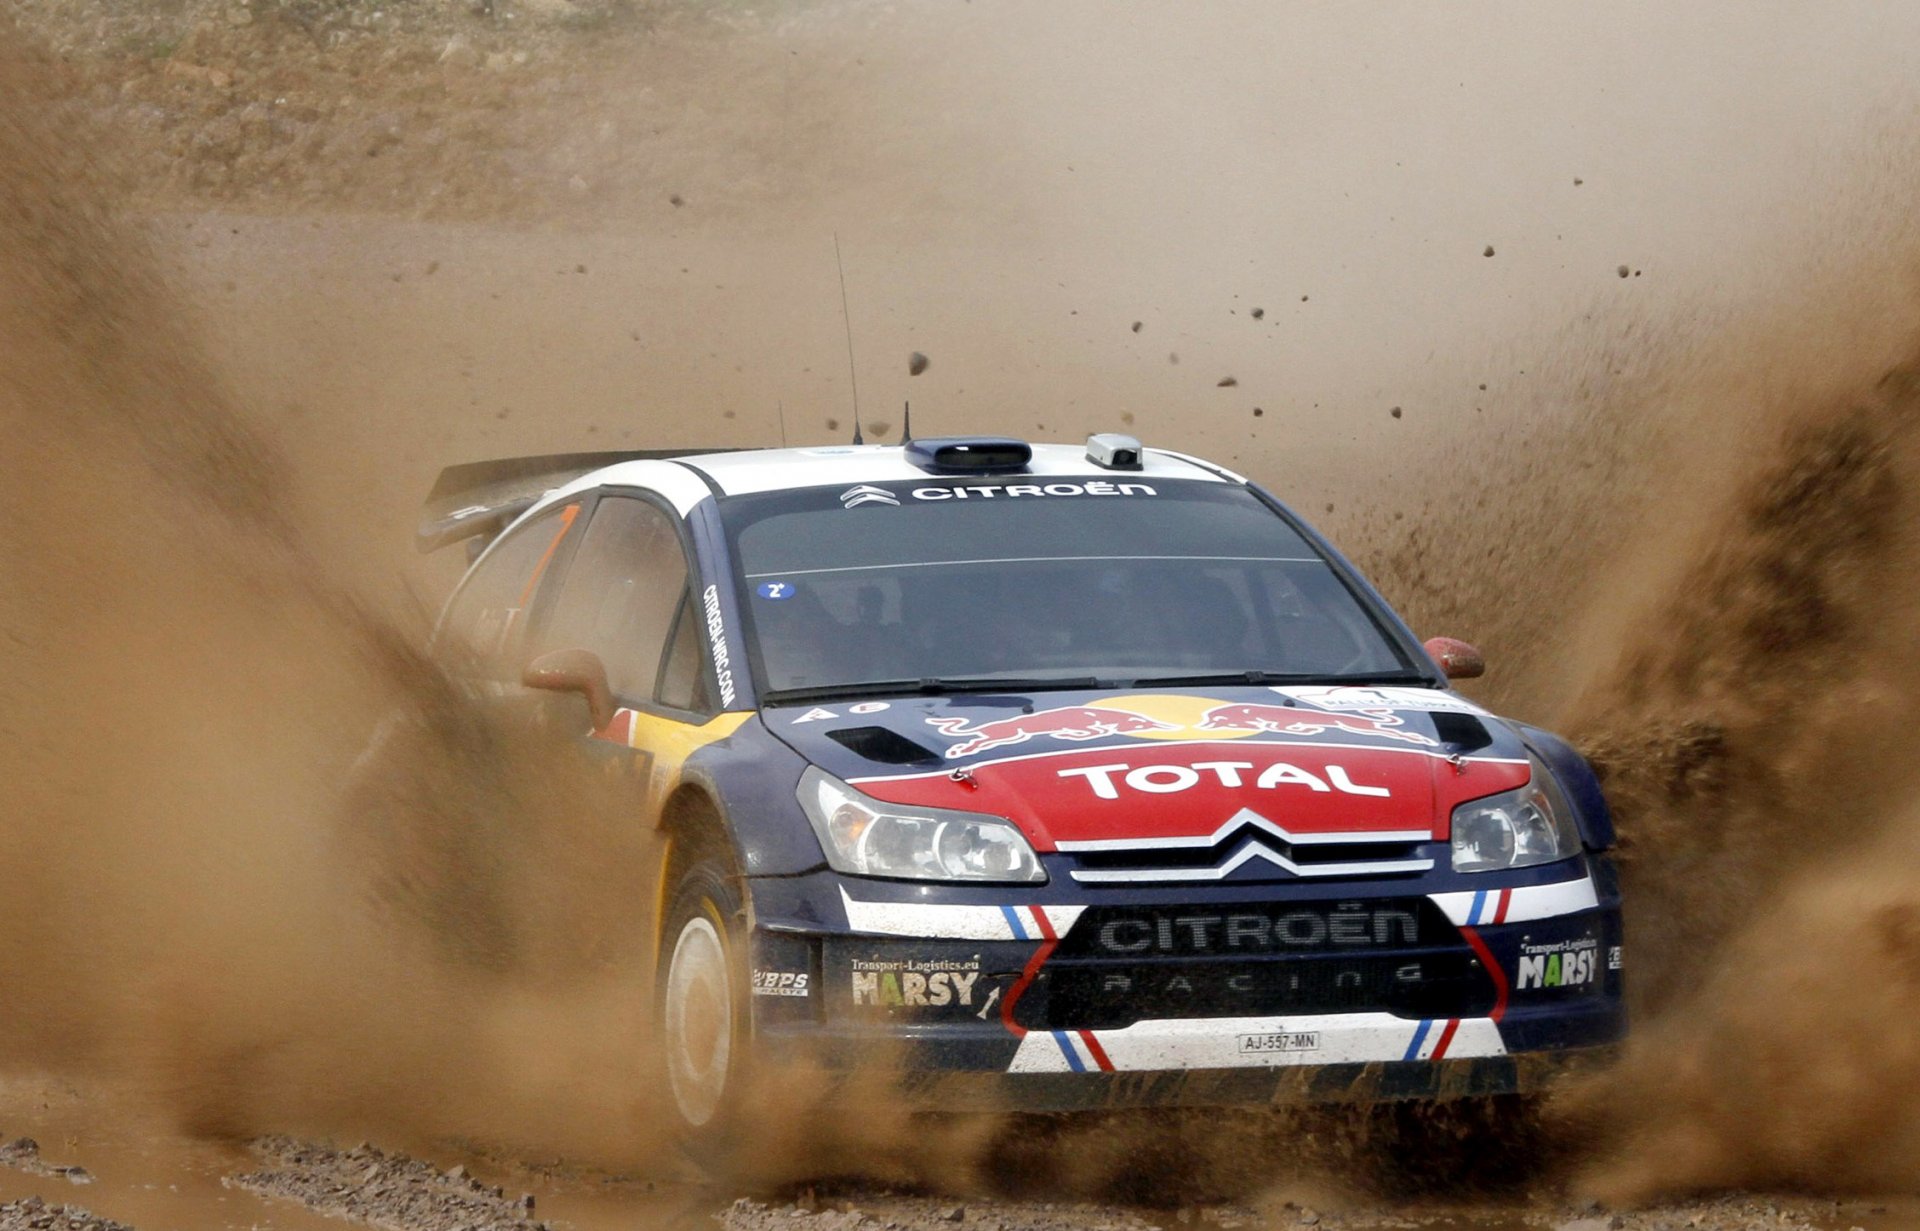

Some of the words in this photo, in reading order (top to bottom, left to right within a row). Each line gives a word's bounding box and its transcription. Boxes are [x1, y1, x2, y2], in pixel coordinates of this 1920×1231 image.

[703, 584, 736, 708] CITROEN-WRC.COM
[1056, 761, 1391, 799] TOTAL
[1100, 904, 1418, 950] CITROËN
[1516, 948, 1598, 989] MARSY
[852, 971, 980, 1006] MARSY
[1245, 1034, 1316, 1050] AJ-557-MN
